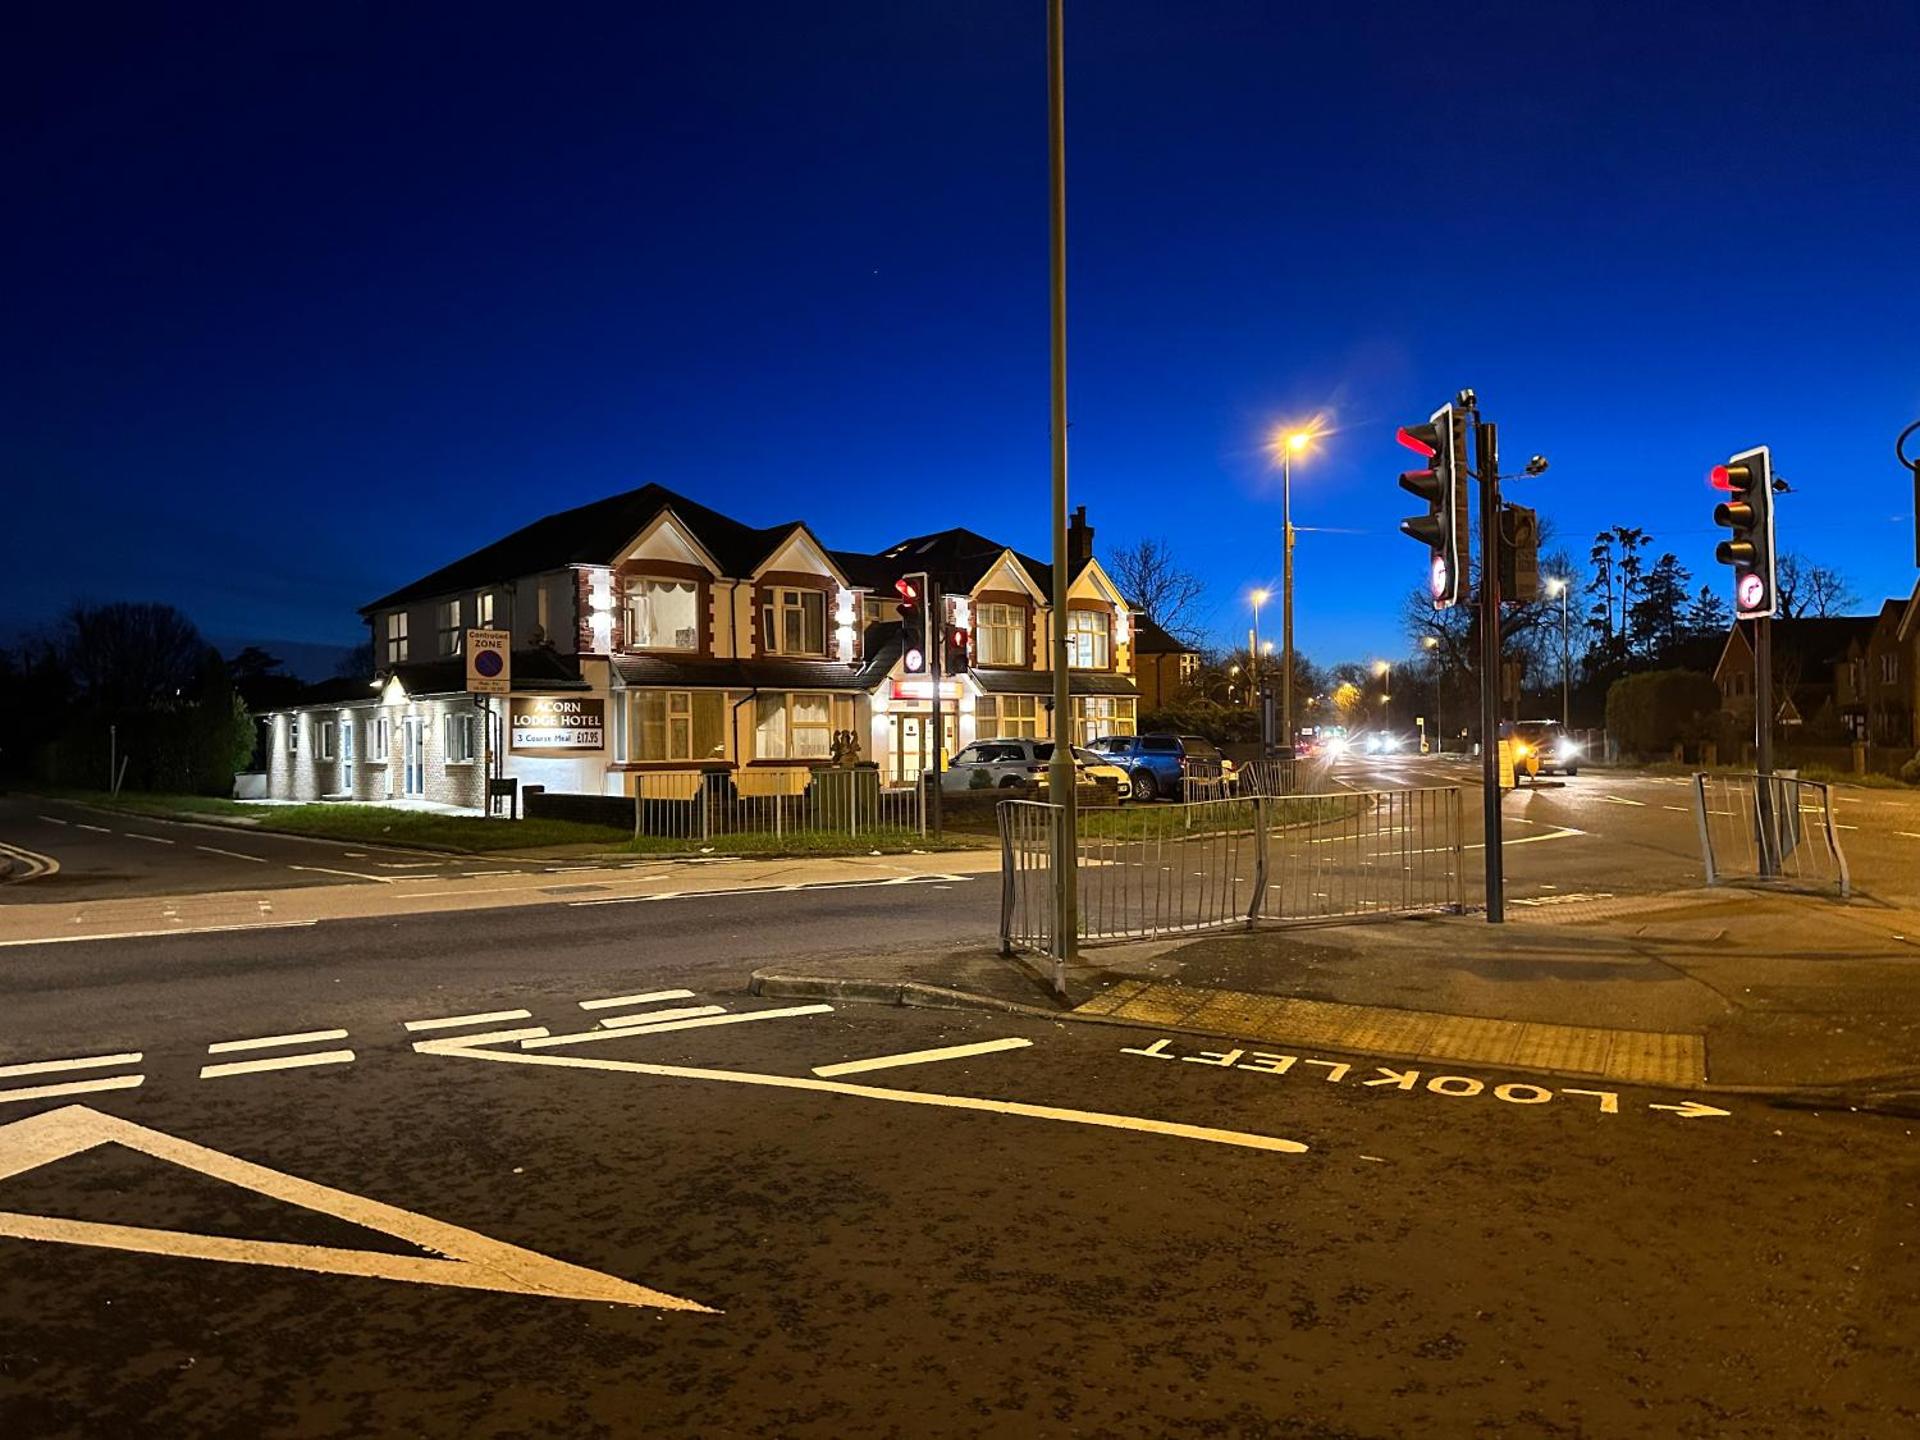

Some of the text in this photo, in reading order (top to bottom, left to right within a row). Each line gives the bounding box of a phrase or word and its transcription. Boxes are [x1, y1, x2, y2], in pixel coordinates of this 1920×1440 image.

[475, 639, 503, 649] ZONE
[535, 702, 581, 713] ACORN
[514, 715, 601, 726] LODGE HOTEL
[517, 732, 598, 743] 3 Course Meal £17.95
[1120, 1038, 1620, 1114] LOOK LEFT
